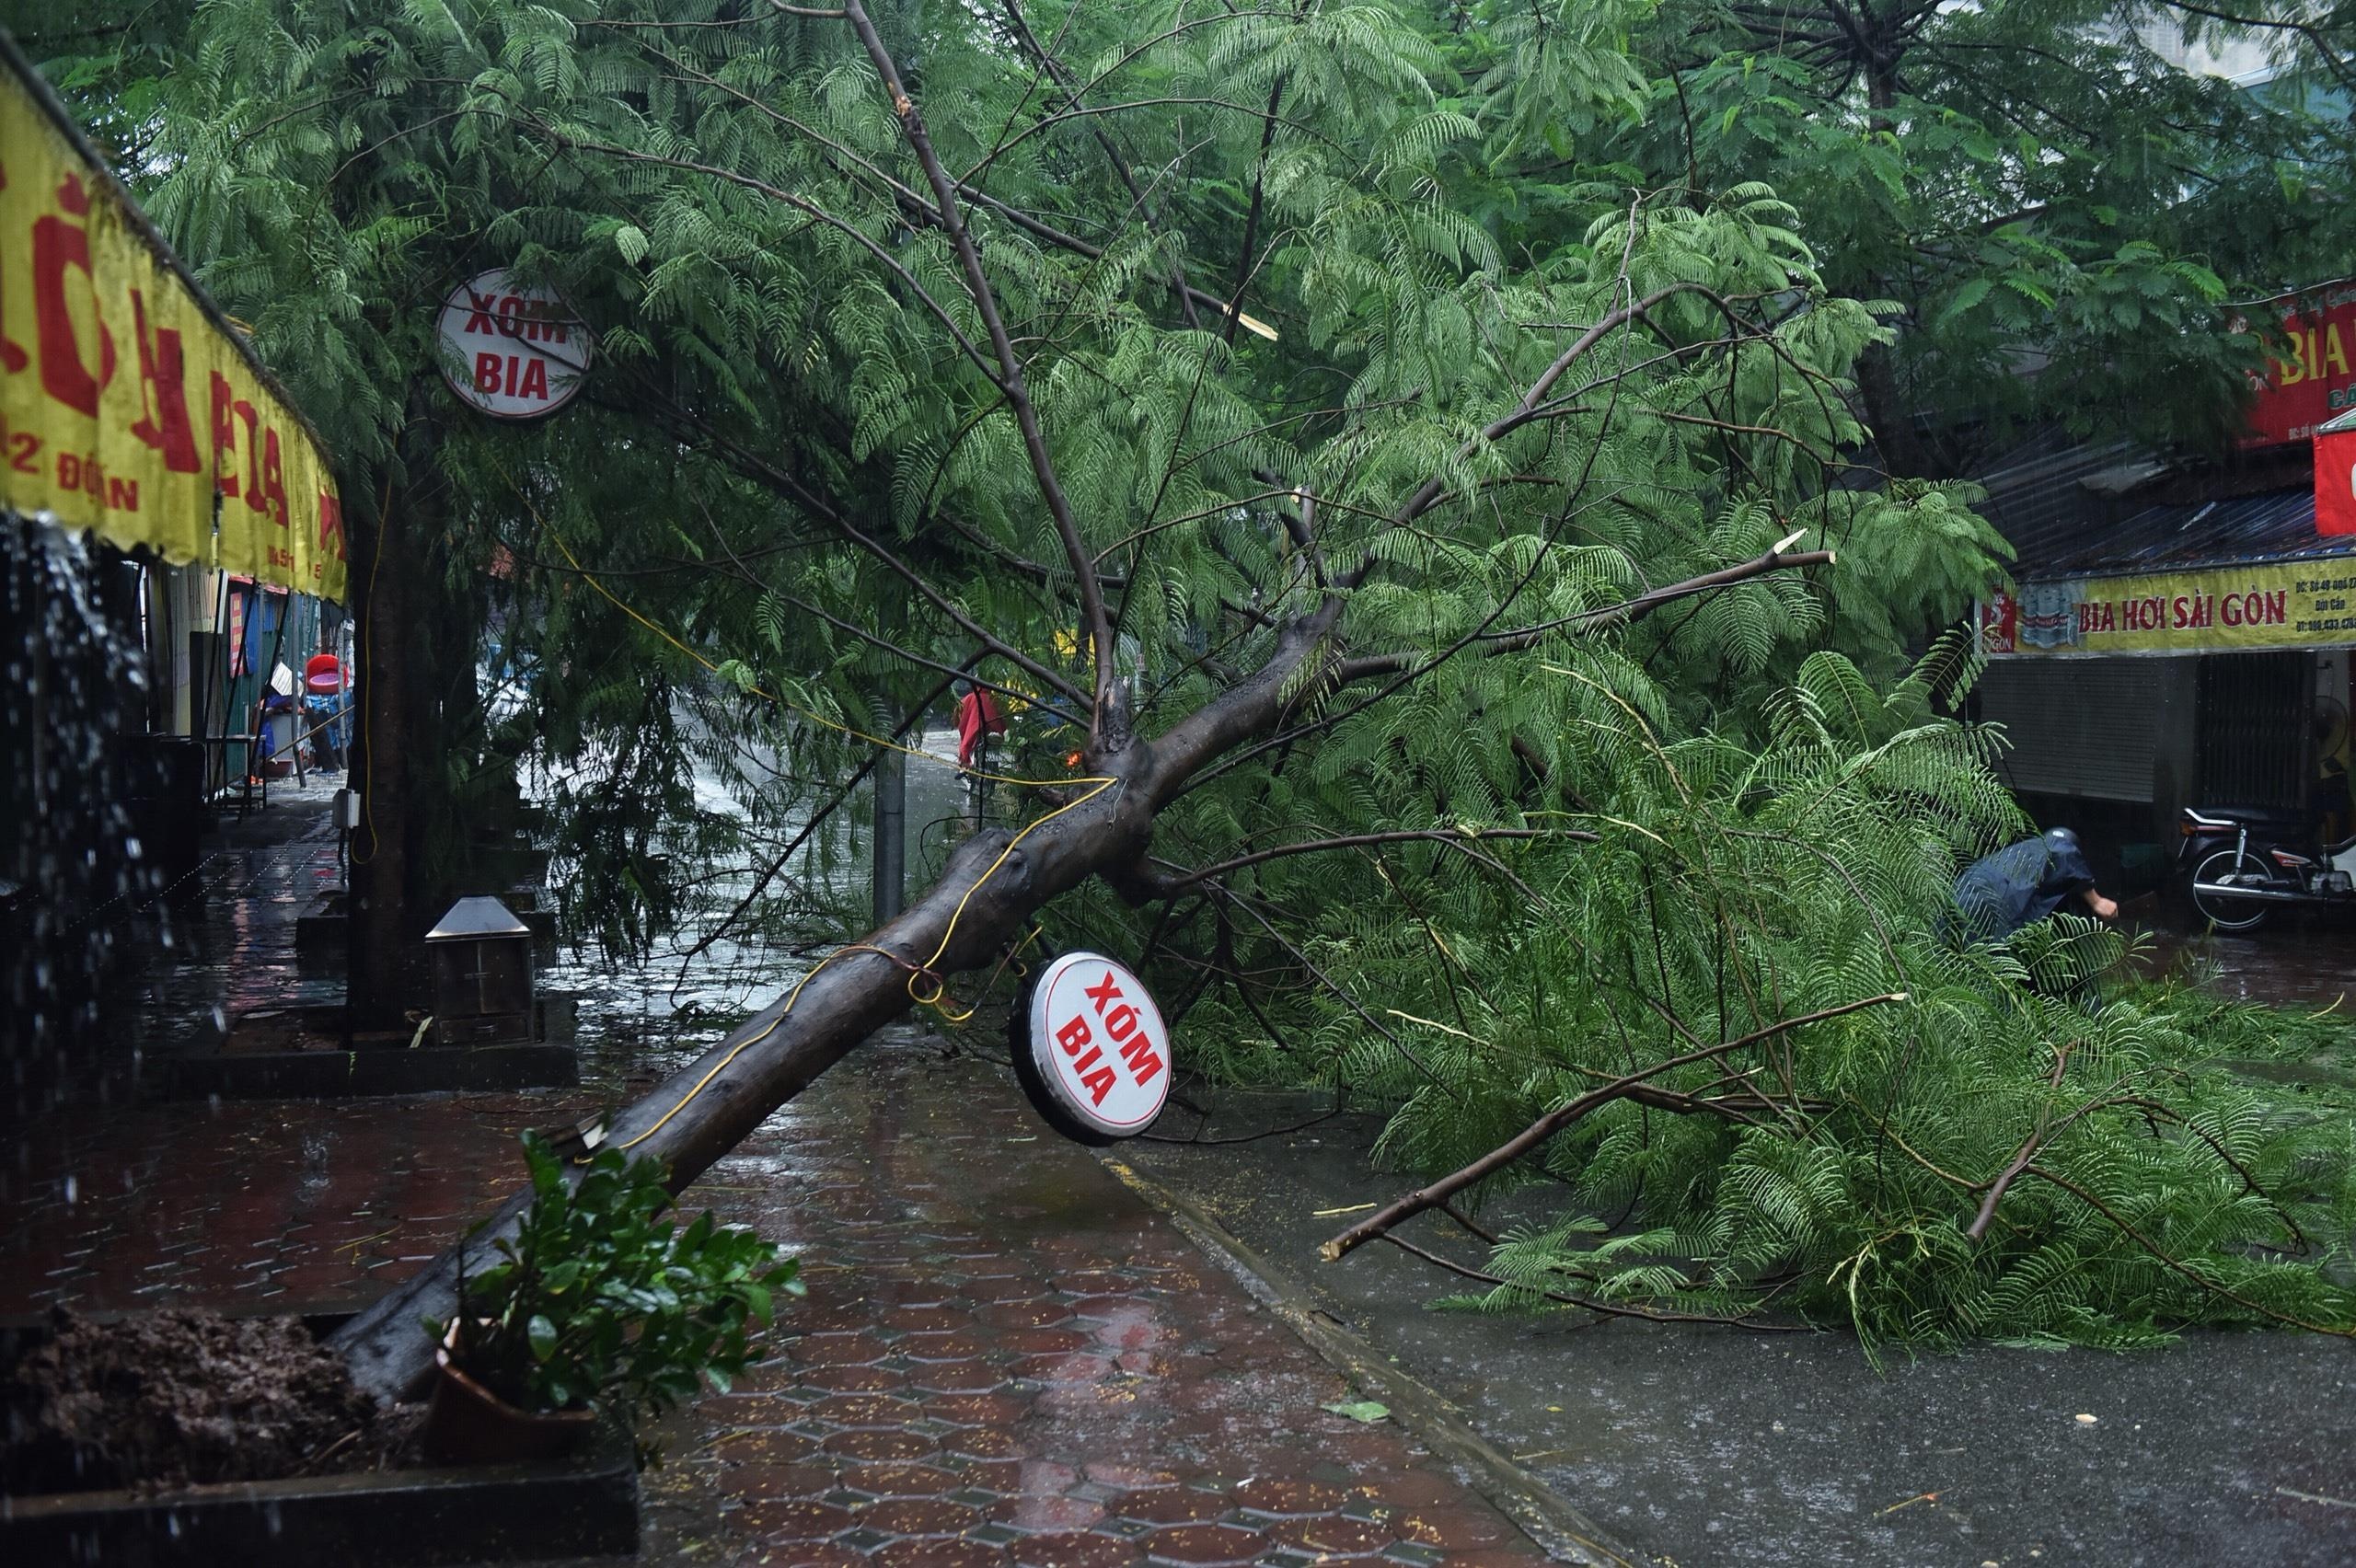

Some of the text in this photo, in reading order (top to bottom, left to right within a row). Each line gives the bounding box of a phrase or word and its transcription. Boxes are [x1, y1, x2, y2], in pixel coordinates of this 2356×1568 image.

[464, 286, 568, 344] XÓM
[473, 352, 549, 401] BIA
[2281, 322, 2350, 386] BIA
[2079, 601, 2117, 633] BIA
[2121, 596, 2166, 631] HƠI
[2173, 588, 2214, 630] SÀI
[2220, 584, 2287, 627] GÒN
[1084, 970, 1163, 1088] XÓM
[1056, 1014, 1117, 1108] BIA
